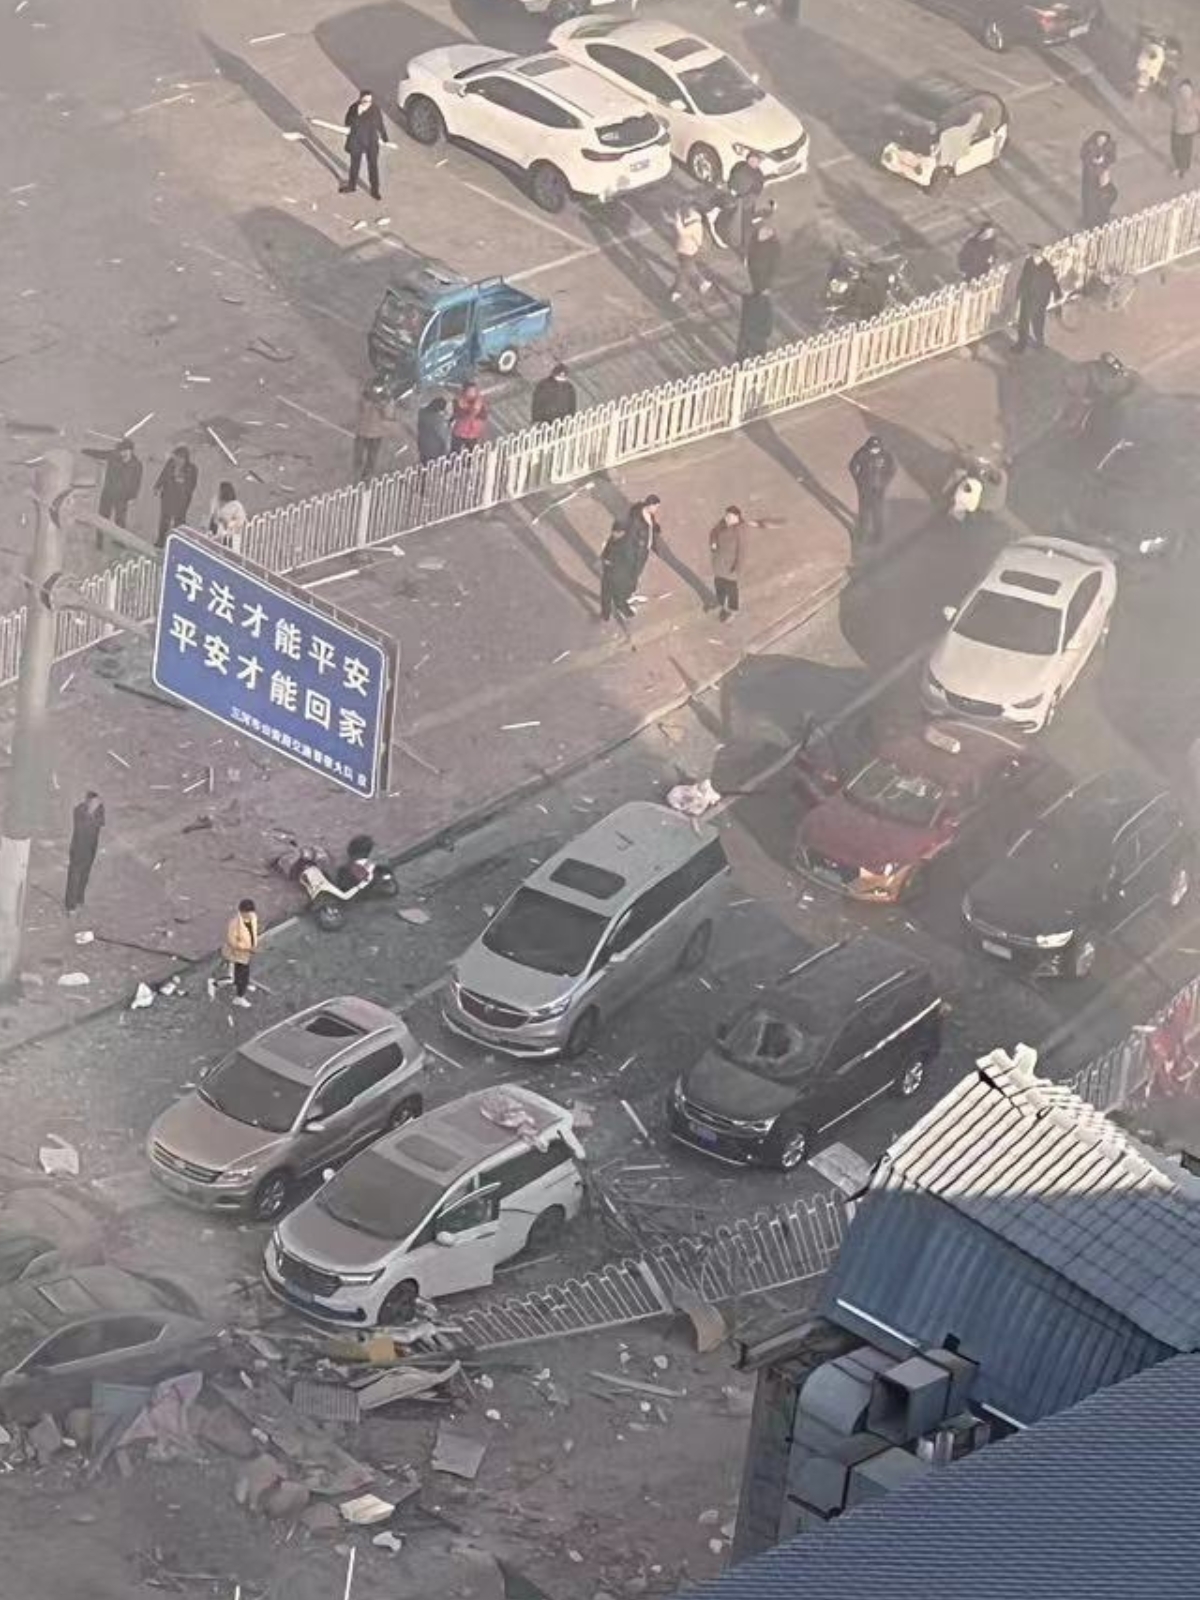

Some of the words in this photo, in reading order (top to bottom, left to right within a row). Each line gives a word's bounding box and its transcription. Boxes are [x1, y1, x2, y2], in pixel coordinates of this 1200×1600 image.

[170, 614, 365, 747] 平安才能回家
[175, 564, 370, 696] 守法才能平安
